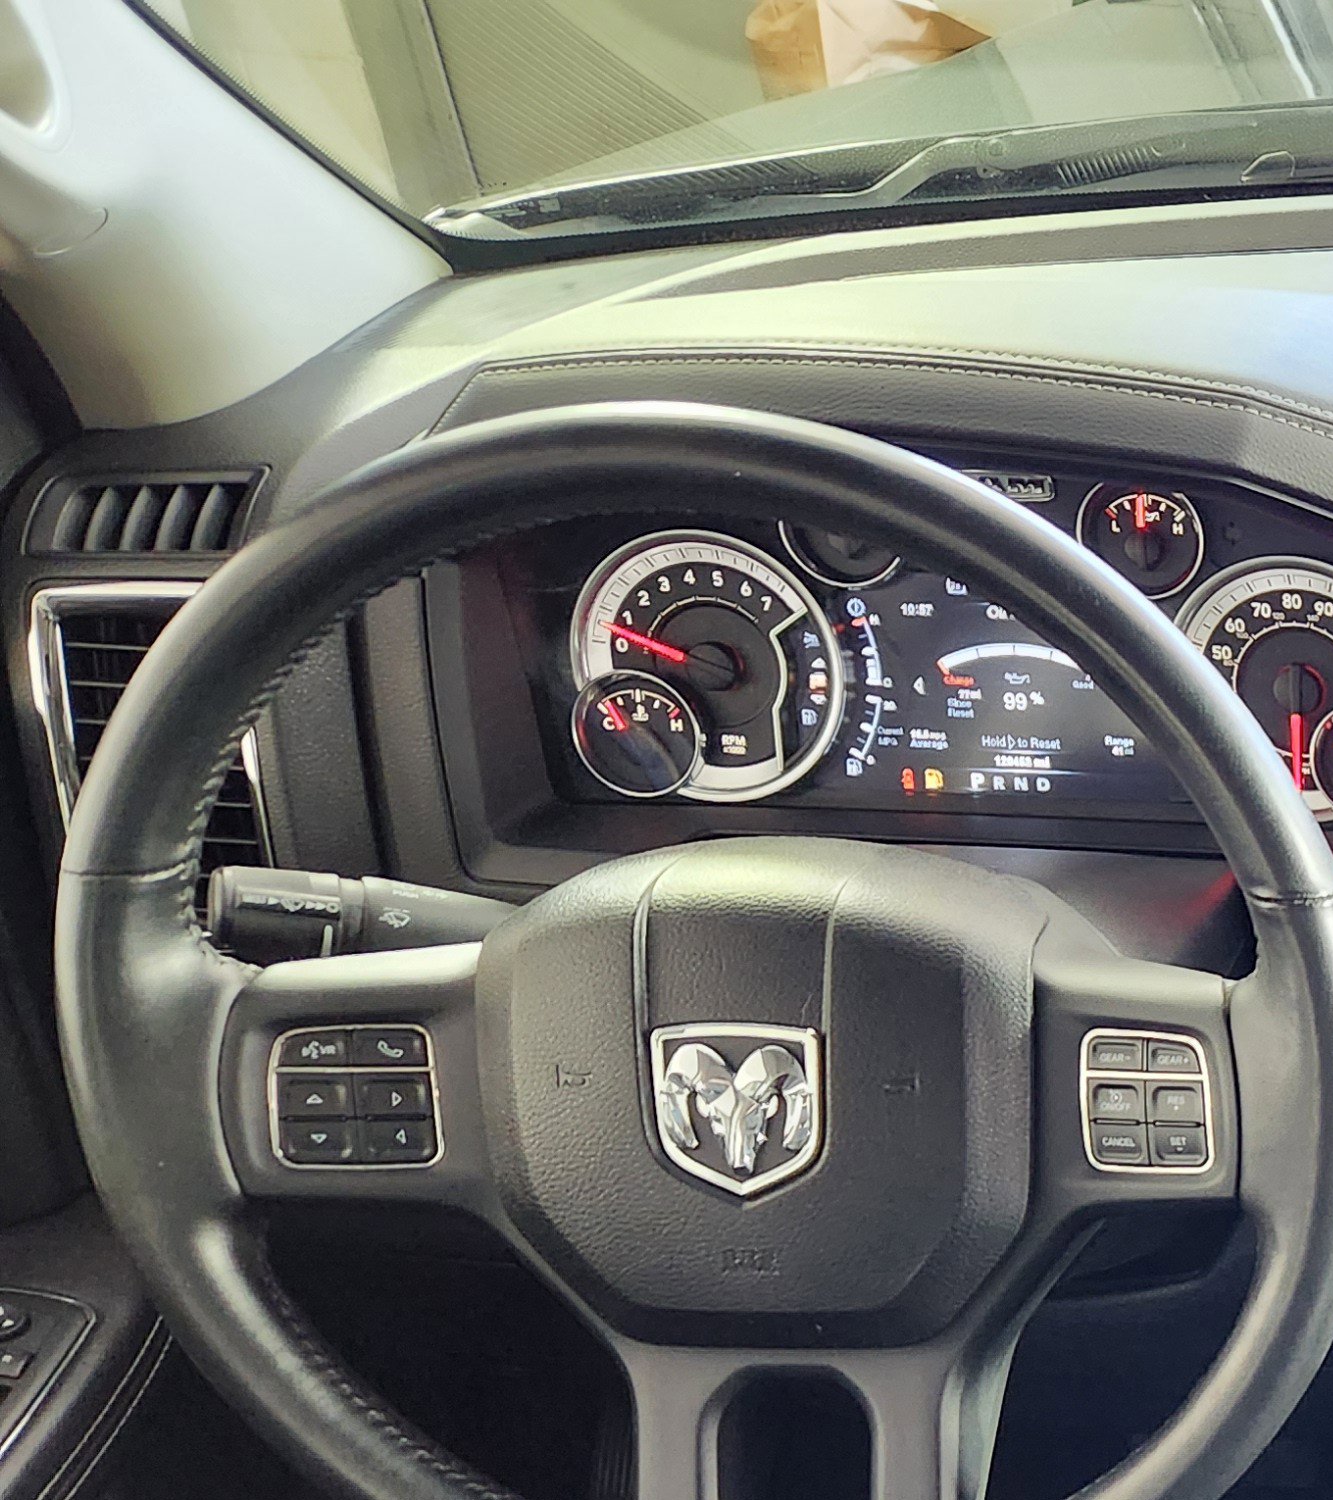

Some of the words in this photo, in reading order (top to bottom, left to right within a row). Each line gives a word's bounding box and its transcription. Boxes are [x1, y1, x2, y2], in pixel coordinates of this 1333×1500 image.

[1172, 522, 1184, 535] H
[657, 576, 671, 592] 3
[683, 569, 696, 585] 4
[711, 570, 724, 587] 5
[740, 581, 752, 597] 6
[636, 590, 650, 607] 2
[761, 596, 773, 611] 7
[1281, 593, 1302, 609] 80
[900, 603, 934, 617] 10:57
[1251, 602, 1272, 618] 70
[621, 611, 633, 625] 1
[1224, 618, 1245, 633] 60
[615, 638, 629, 653] 0
[1212, 645, 1232, 660] 50
[1003, 691, 1028, 711] 99
[602, 717, 616, 731] C
[670, 719, 683, 732] H
[721, 734, 747, 746] RPM
[982, 735, 1006, 748] Hold
[1018, 737, 1028, 748] to
[1030, 738, 1061, 750] Reset
[971, 773, 985, 790] P
[993, 776, 1006, 791] R
[1014, 777, 1029, 791] N
[1036, 777, 1051, 791] D
[1102, 1136, 1136, 1148] CANCEL
